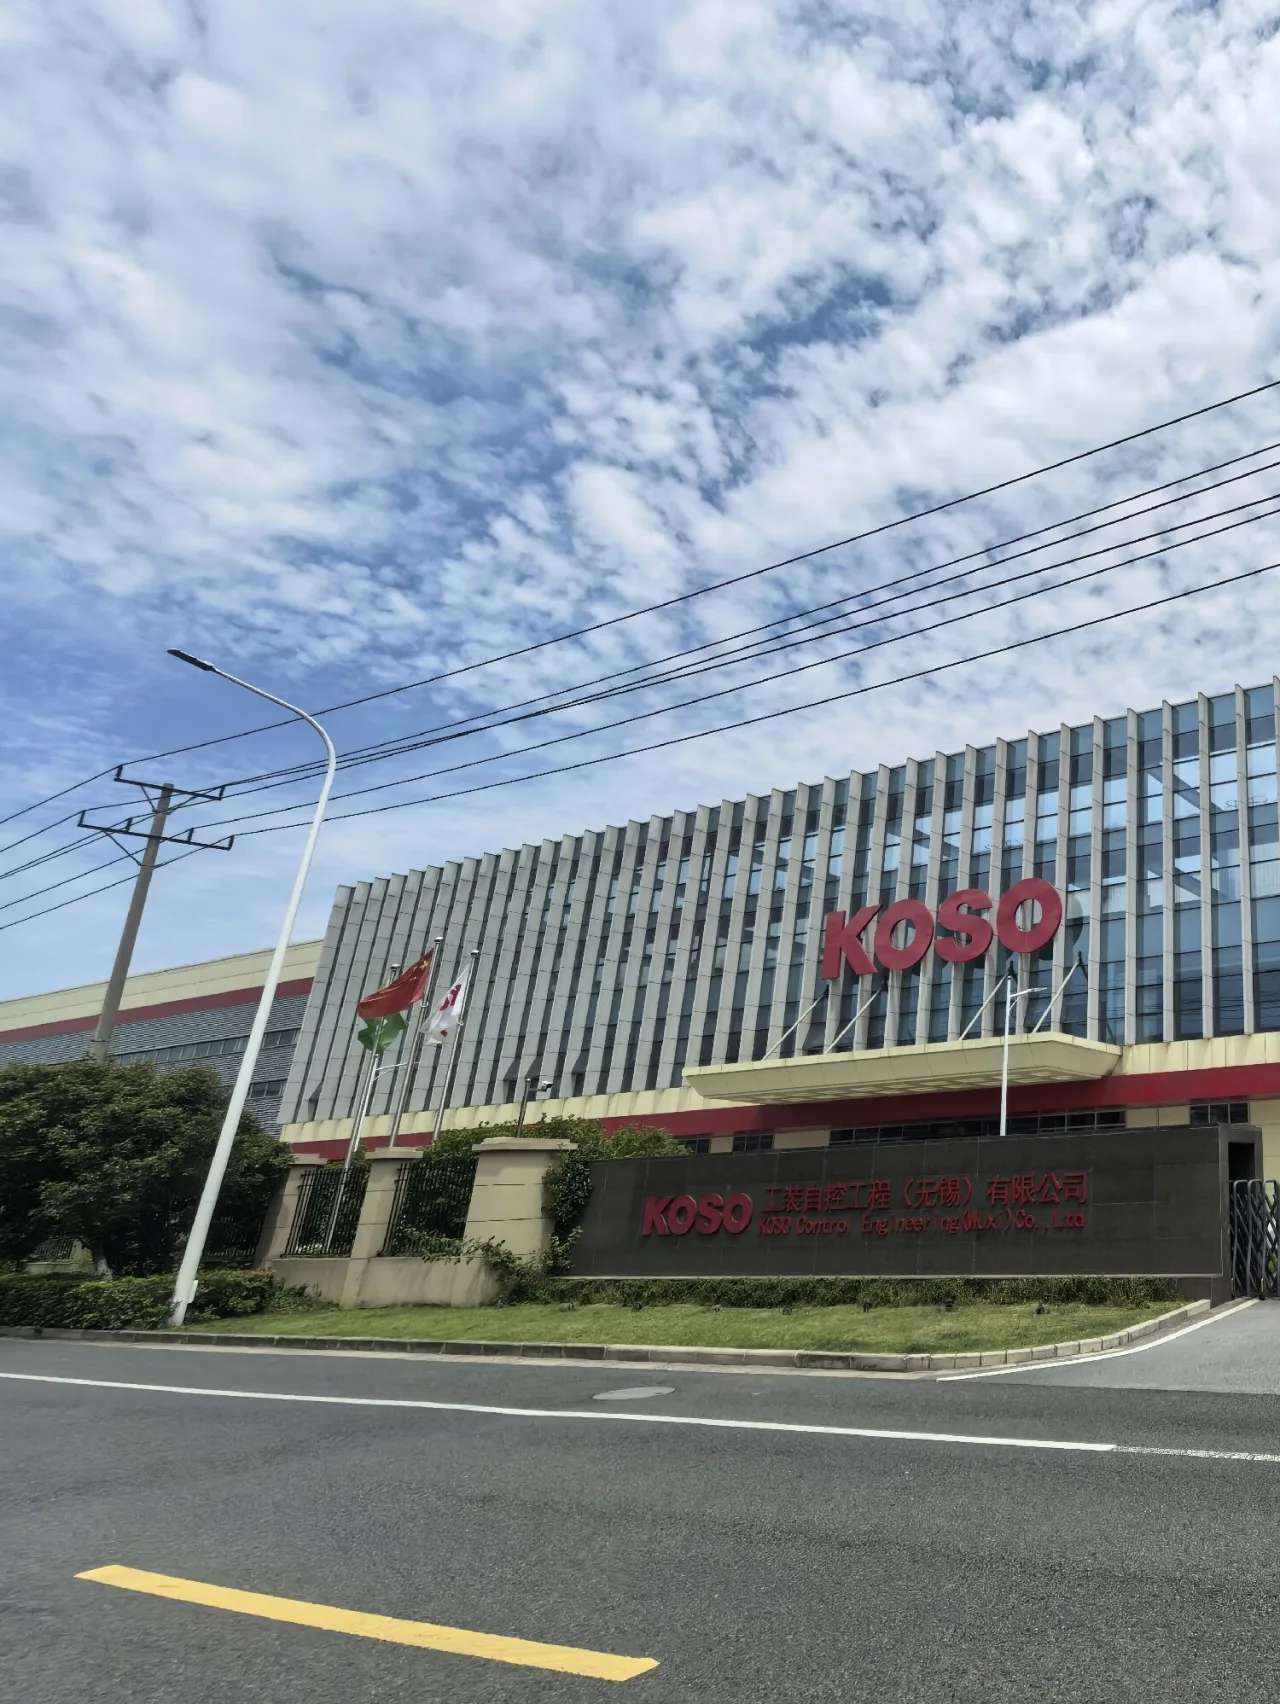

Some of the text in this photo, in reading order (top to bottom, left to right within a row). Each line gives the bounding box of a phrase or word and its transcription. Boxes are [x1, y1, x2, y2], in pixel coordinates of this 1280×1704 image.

[821, 877, 1062, 980] KOSO
[641, 1192, 753, 1237] KOSO
[759, 1172, 1089, 1214] 工装自控工程（无锡）有限公司
[758, 1215, 792, 1236] KOSO
[796, 1214, 852, 1236] Control
